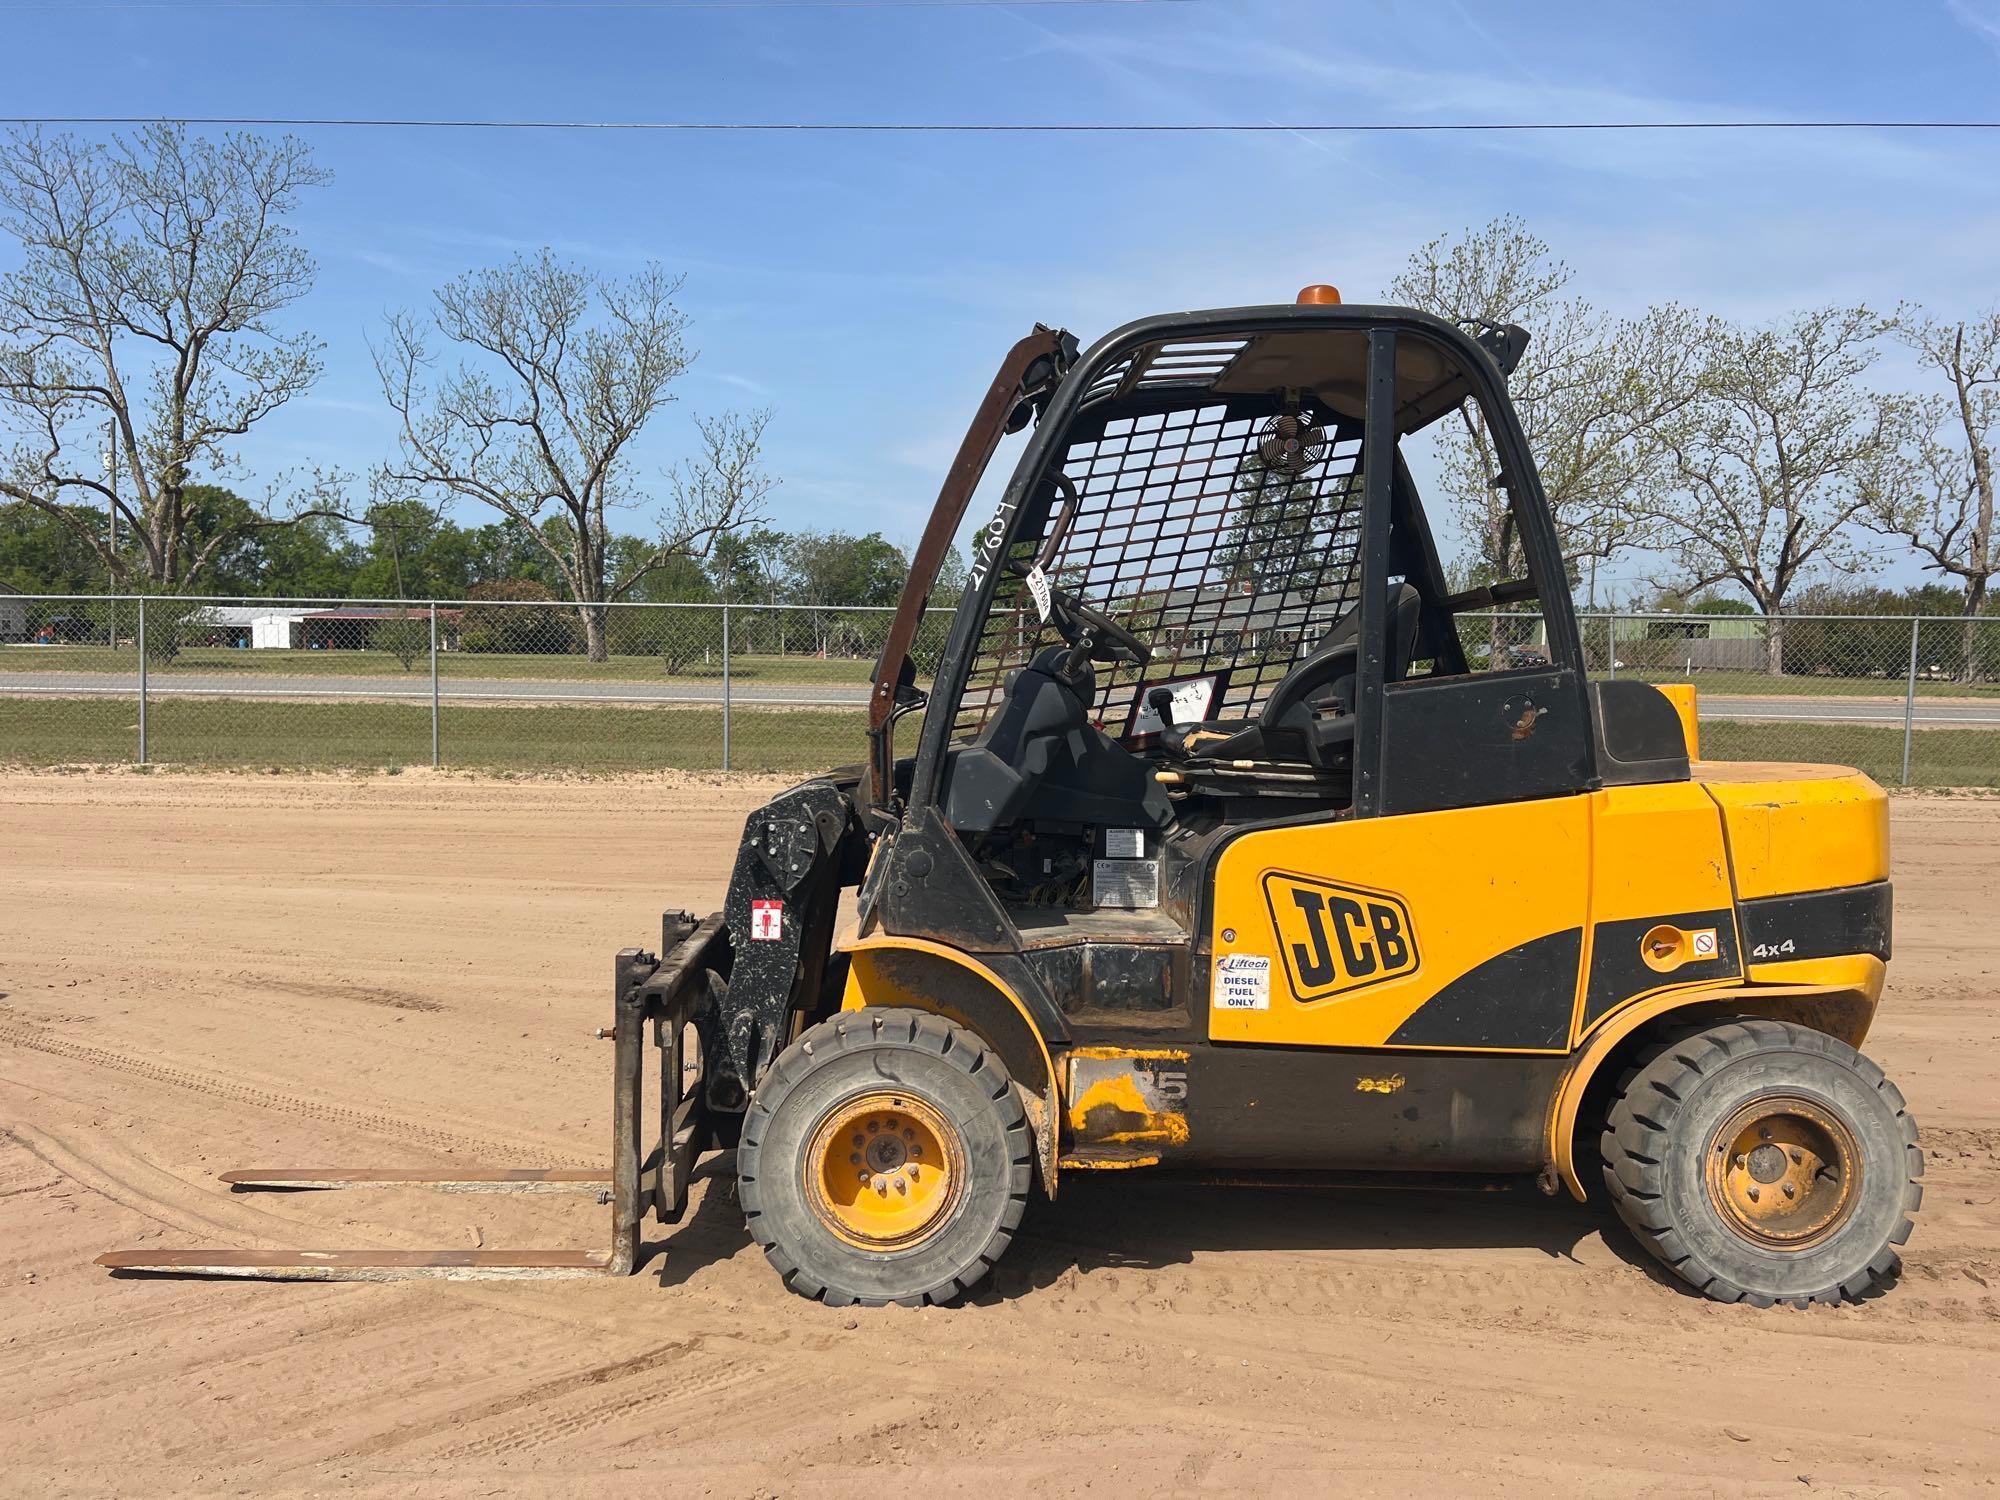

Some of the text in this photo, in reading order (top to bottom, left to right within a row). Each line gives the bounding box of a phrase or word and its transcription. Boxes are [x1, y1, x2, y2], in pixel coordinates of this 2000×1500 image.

[970, 502, 1018, 592] 217604
[1035, 577, 1051, 611] 217604
[1291, 888, 1409, 988] JCB
[1752, 938, 1796, 959] 4x4
[1228, 958, 1269, 970] Liftech
[1224, 977, 1260, 985] DIESEL
[1229, 988, 1255, 996] FUEL
[1228, 998, 1255, 1006] ONLY
